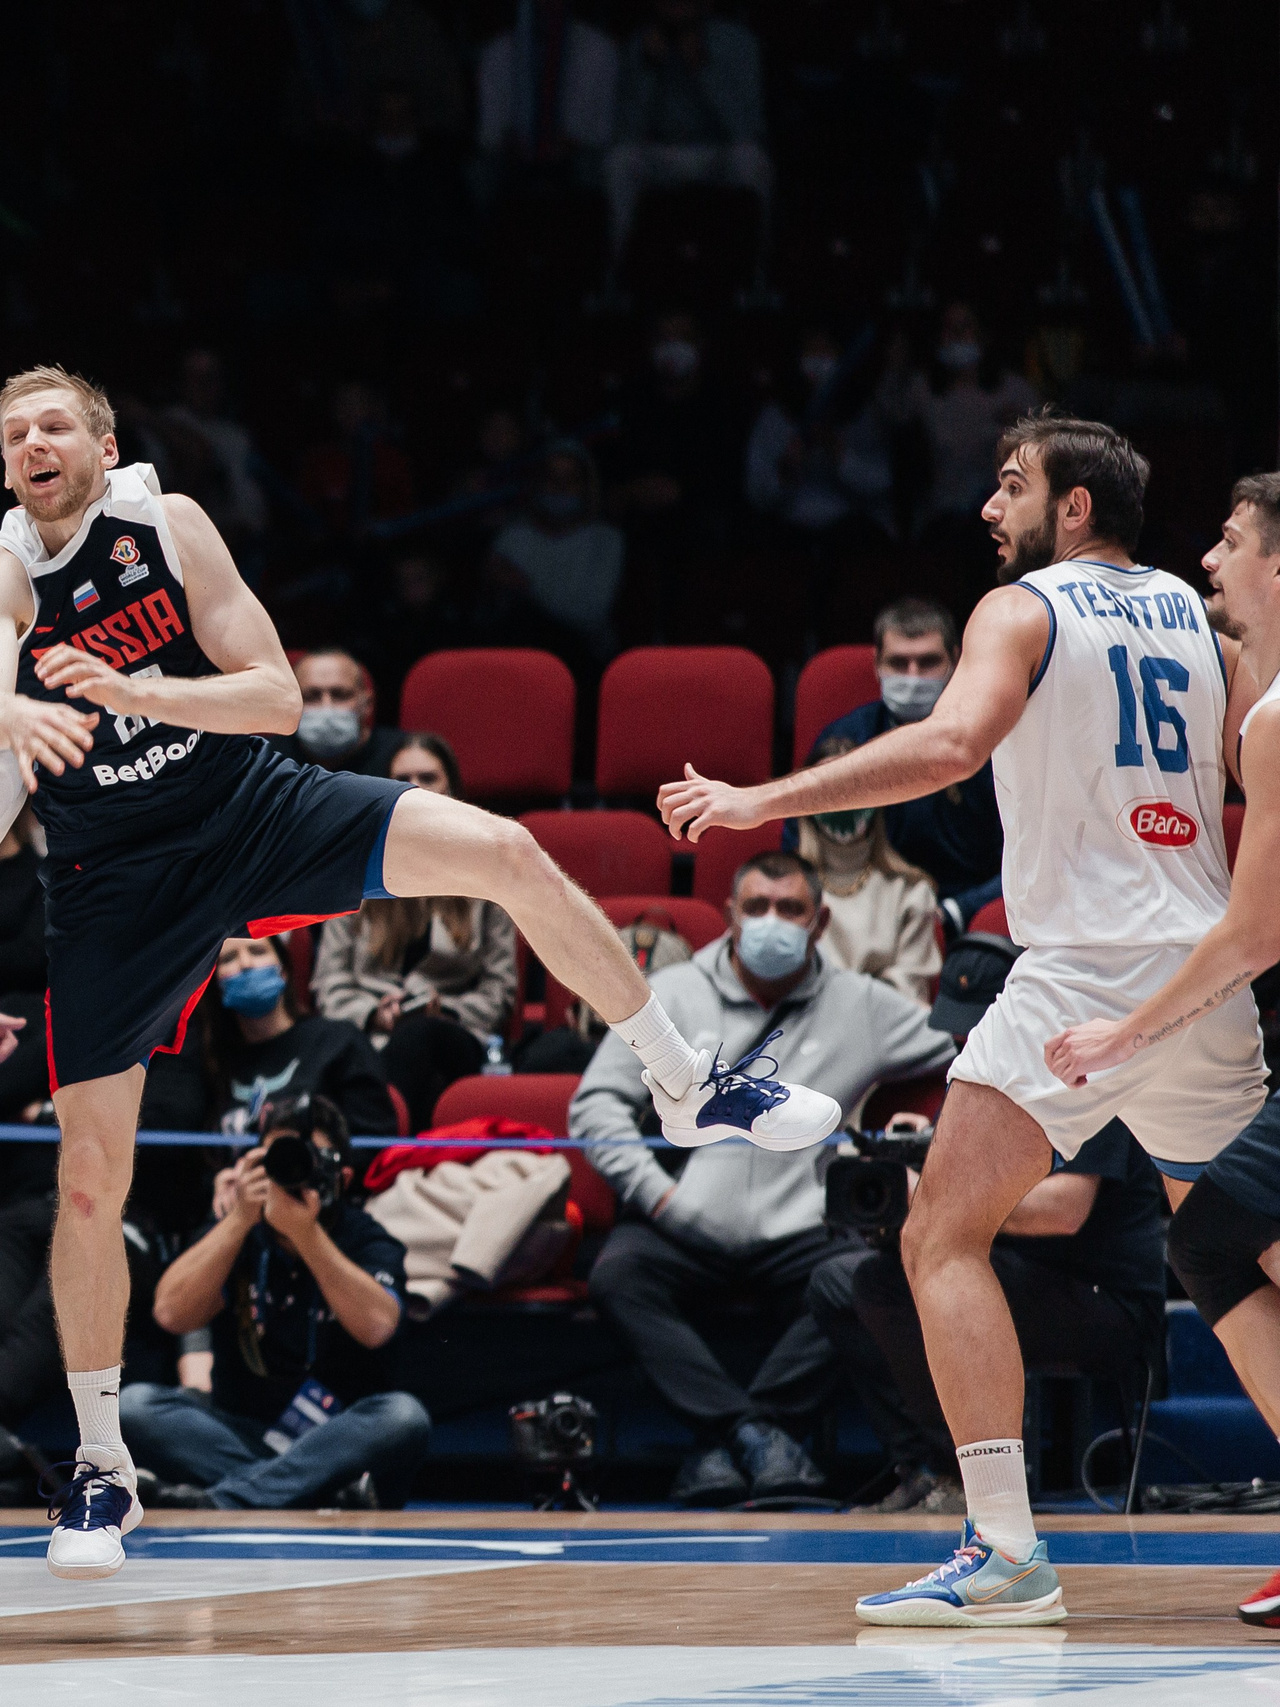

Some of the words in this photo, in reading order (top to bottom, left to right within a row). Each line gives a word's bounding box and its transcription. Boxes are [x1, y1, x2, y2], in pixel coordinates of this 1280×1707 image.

[31, 588, 184, 684] SSIA
[1107, 644, 1190, 773] 16
[92, 729, 204, 787] BetBoo
[958, 1446, 1012, 1460] ALDING
